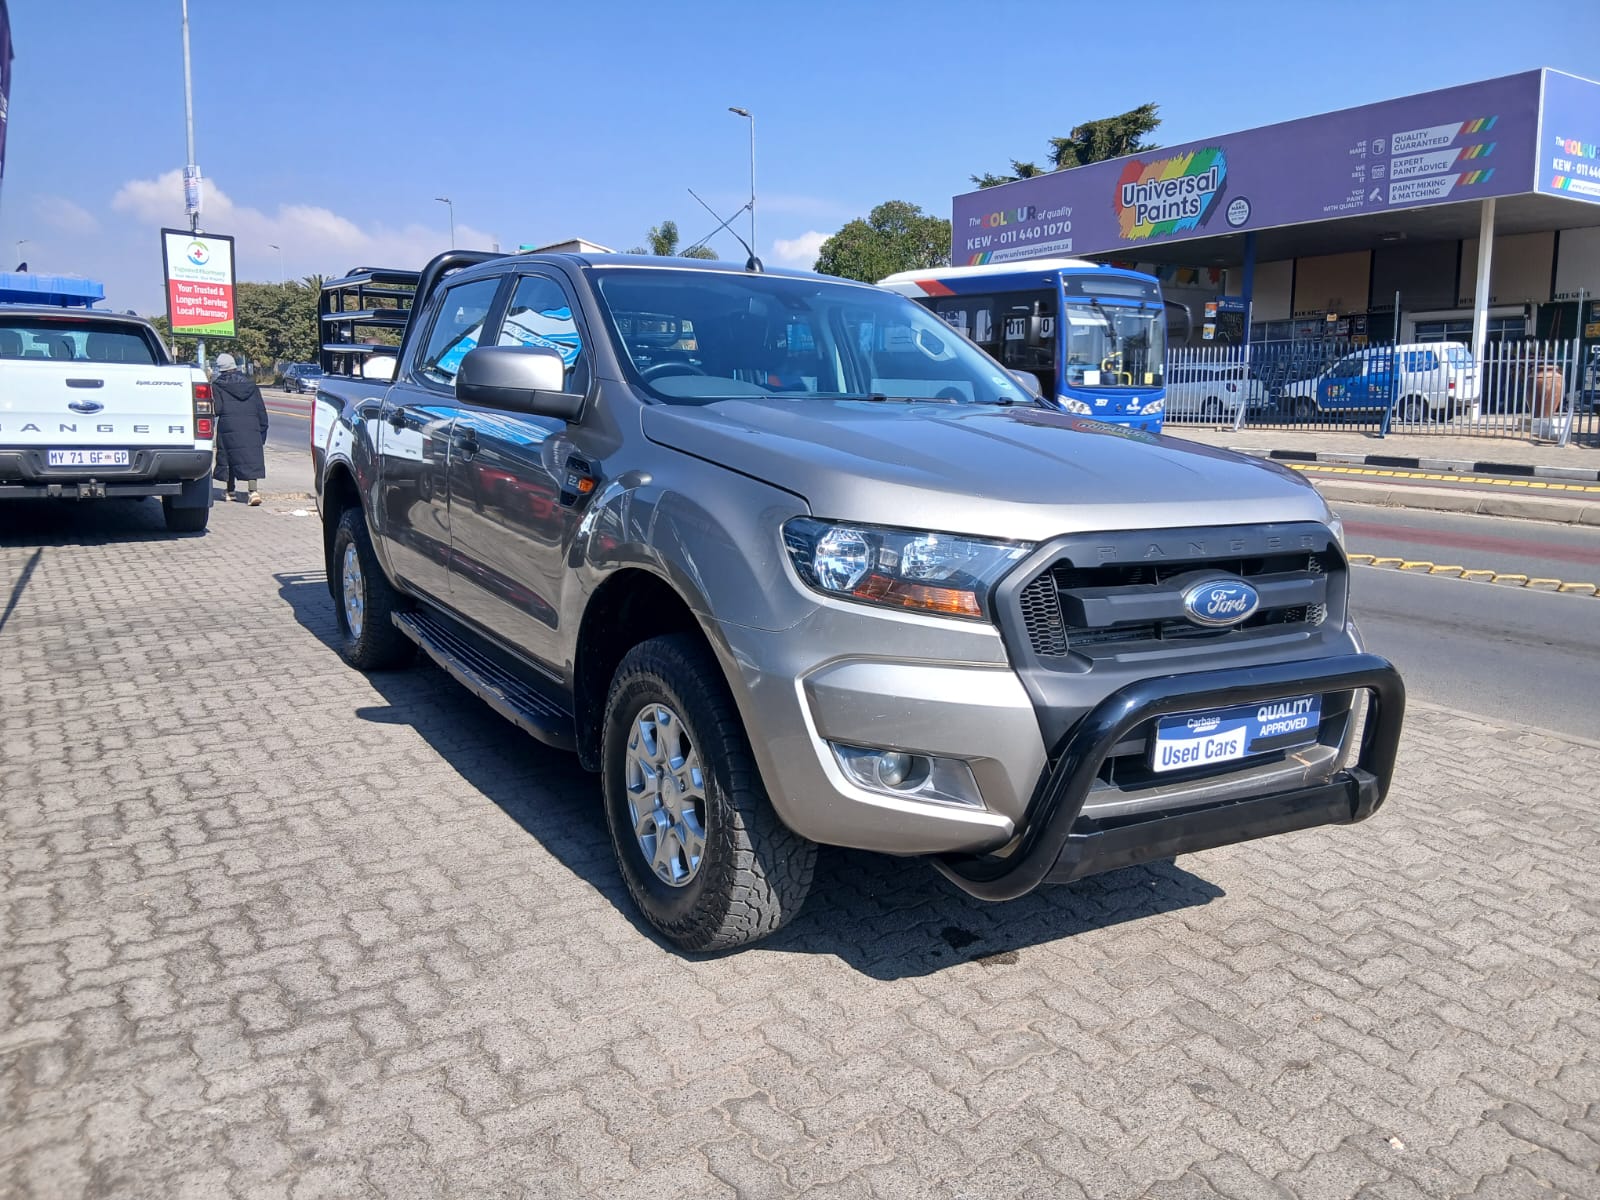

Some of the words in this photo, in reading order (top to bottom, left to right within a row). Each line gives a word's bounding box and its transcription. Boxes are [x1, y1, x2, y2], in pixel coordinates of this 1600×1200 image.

[1394, 131, 1429, 144] QUALITY
[1394, 136, 1449, 151] GUARANTEED
[1393, 157, 1424, 168] EXPERT
[1393, 166, 1416, 177] PAINT
[1418, 162, 1448, 173] ADVICE
[1553, 158, 1571, 172] KEW
[1576, 163, 1588, 176] 011
[1122, 166, 1218, 207] Universal
[1392, 183, 1415, 193] PAINT
[1417, 179, 1446, 190] MIXING
[1391, 193, 1397, 201] &
[1398, 188, 1441, 200] MATCHING
[1135, 196, 1201, 227] Paints
[1340, 201, 1364, 211] QUALITY
[969, 217, 981, 227] The
[1037, 210, 1046, 220] of
[1046, 206, 1073, 220] quality
[967, 235, 992, 250] KEW
[1000, 230, 1017, 244] 011
[1019, 226, 1041, 240] 440
[1043, 220, 1072, 237] 1070
[994, 243, 1069, 261] www.universalpaints.co.za
[177, 283, 193, 293] Your
[194, 285, 218, 296] Trusted
[176, 294, 203, 306] Longest
[203, 297, 229, 309] Serving
[176, 306, 195, 316] Local
[195, 307, 229, 321] Pharmacy
[1008, 319, 1025, 335] 011
[0, 423, 185, 434] ANGER
[51, 451, 64, 463] MY
[71, 451, 83, 463] 71
[90, 452, 103, 464] GF
[114, 452, 128, 464] GP
[1096, 534, 1315, 560] RANGER
[1207, 589, 1247, 614] Ford
[1257, 698, 1313, 722] QUALITY
[1187, 716, 1221, 729] Carbase
[1260, 718, 1308, 737] APPROVED
[1162, 742, 1200, 766] Used
[1205, 739, 1238, 759] Cars
